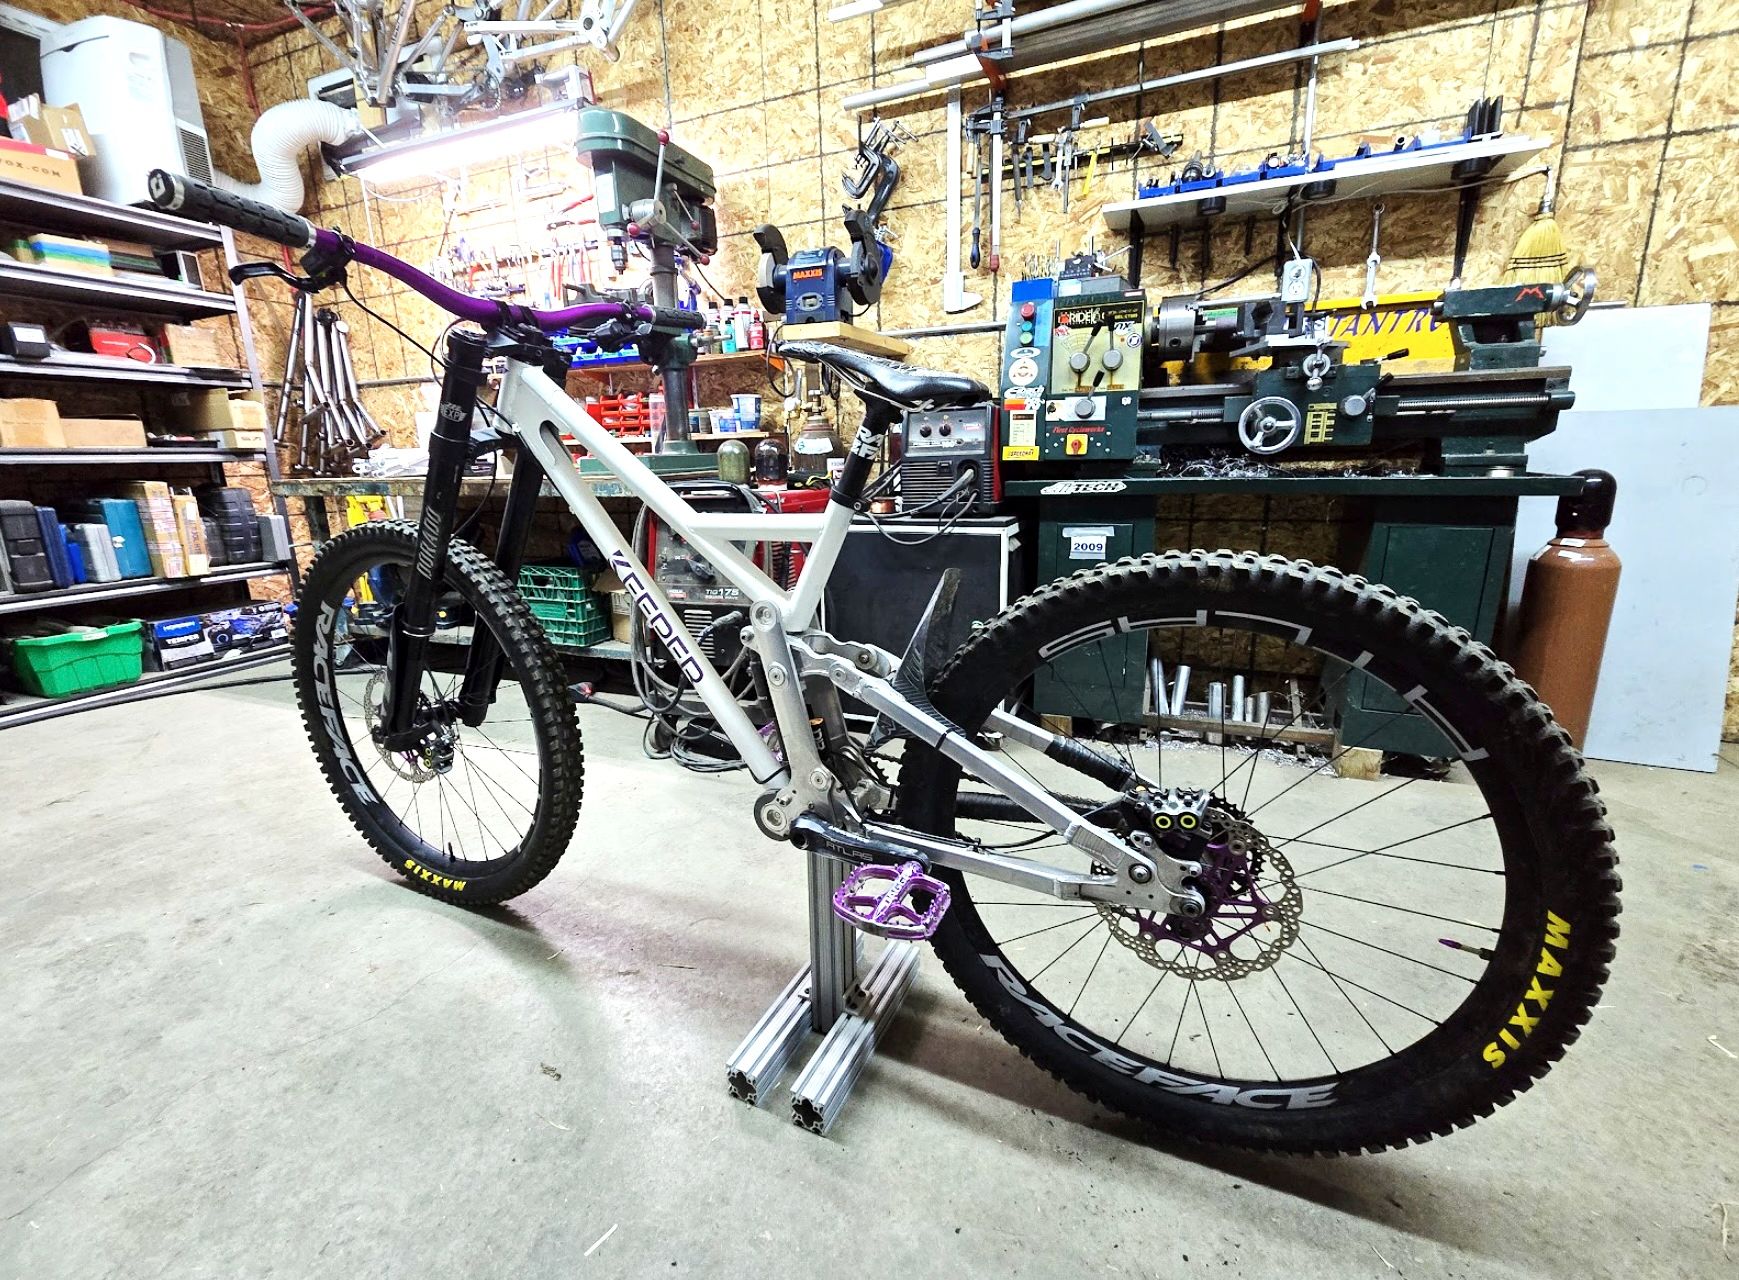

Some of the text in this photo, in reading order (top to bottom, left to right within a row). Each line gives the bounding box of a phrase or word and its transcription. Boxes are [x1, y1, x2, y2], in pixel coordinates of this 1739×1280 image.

[792, 268, 823, 280] MAXXIS
[416, 504, 443, 581] DORADO
[1073, 542, 1104, 552] 2009
[404, 859, 467, 892] MAXXIS
[1482, 909, 1572, 1069] MAXXIS
